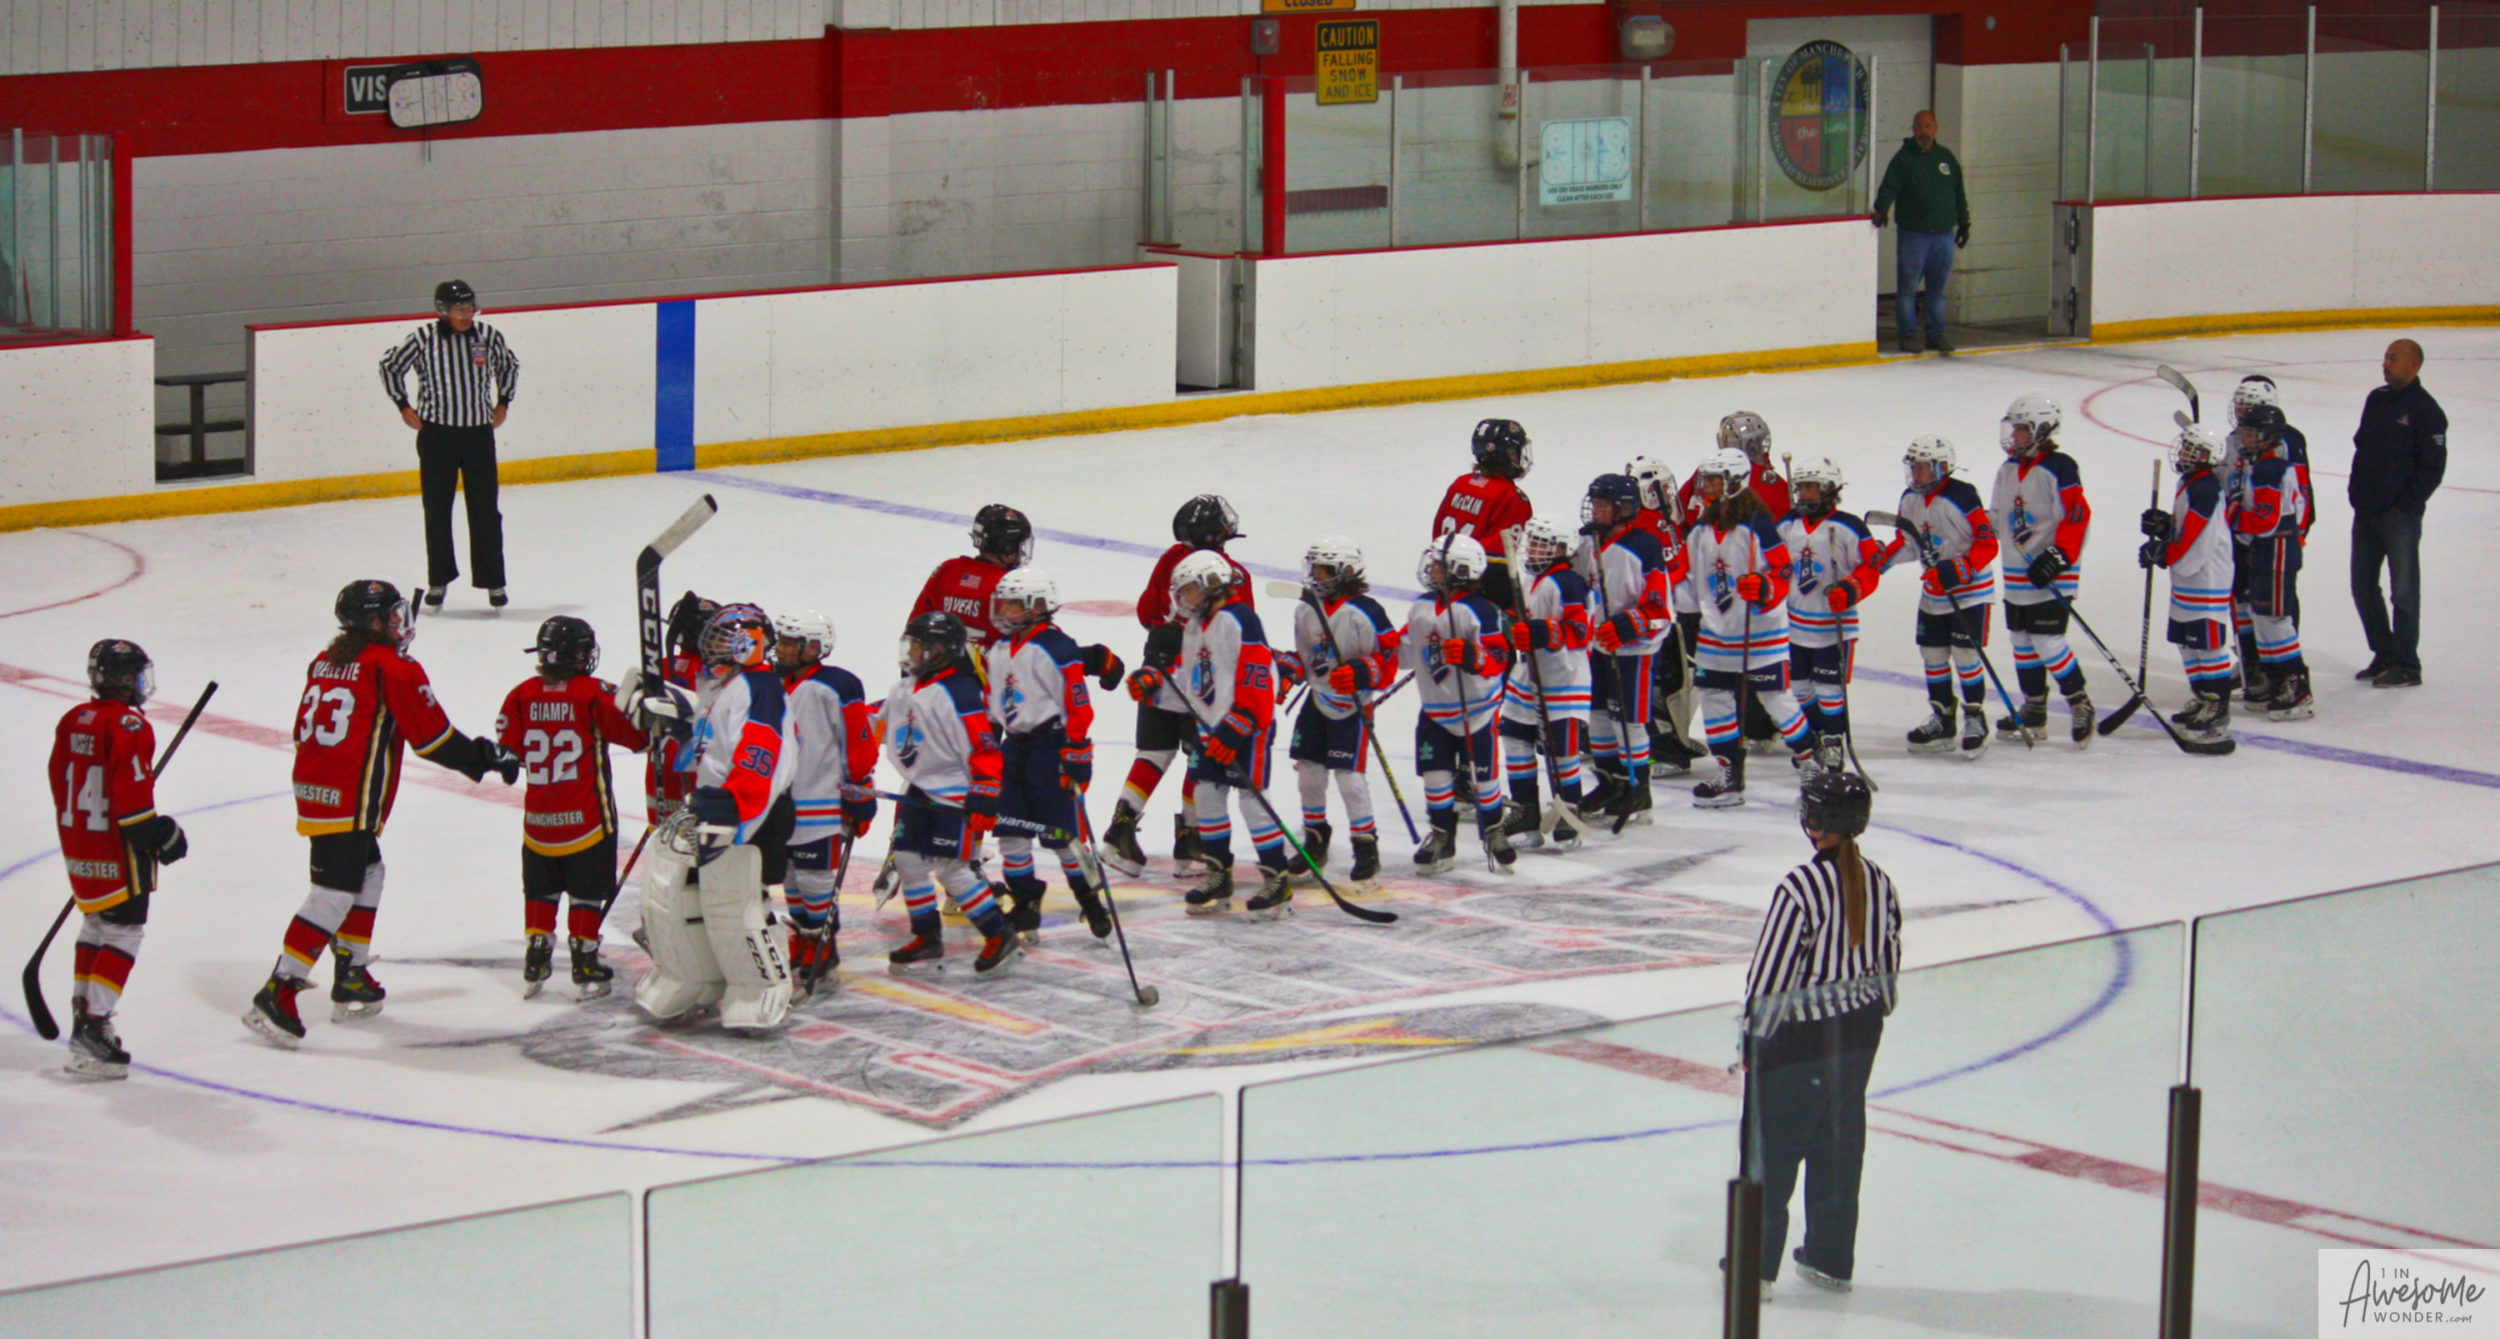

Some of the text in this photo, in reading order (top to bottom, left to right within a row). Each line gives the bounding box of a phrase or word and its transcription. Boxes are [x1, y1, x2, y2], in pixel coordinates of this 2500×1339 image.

[1321, 26, 1375, 48] CAUTION
[1322, 51, 1374, 67] FALLING
[1330, 68, 1367, 83] SNOW
[1326, 83, 1373, 98] AND ICE
[642, 587, 662, 677] CCM
[1242, 662, 1271, 690] 72
[300, 683, 356, 747] 33
[522, 729, 583, 786] 22
[740, 744, 775, 779] 35
[60, 761, 110, 832] 14
[745, 936, 771, 981] CCM
[761, 928, 787, 980] CCM
